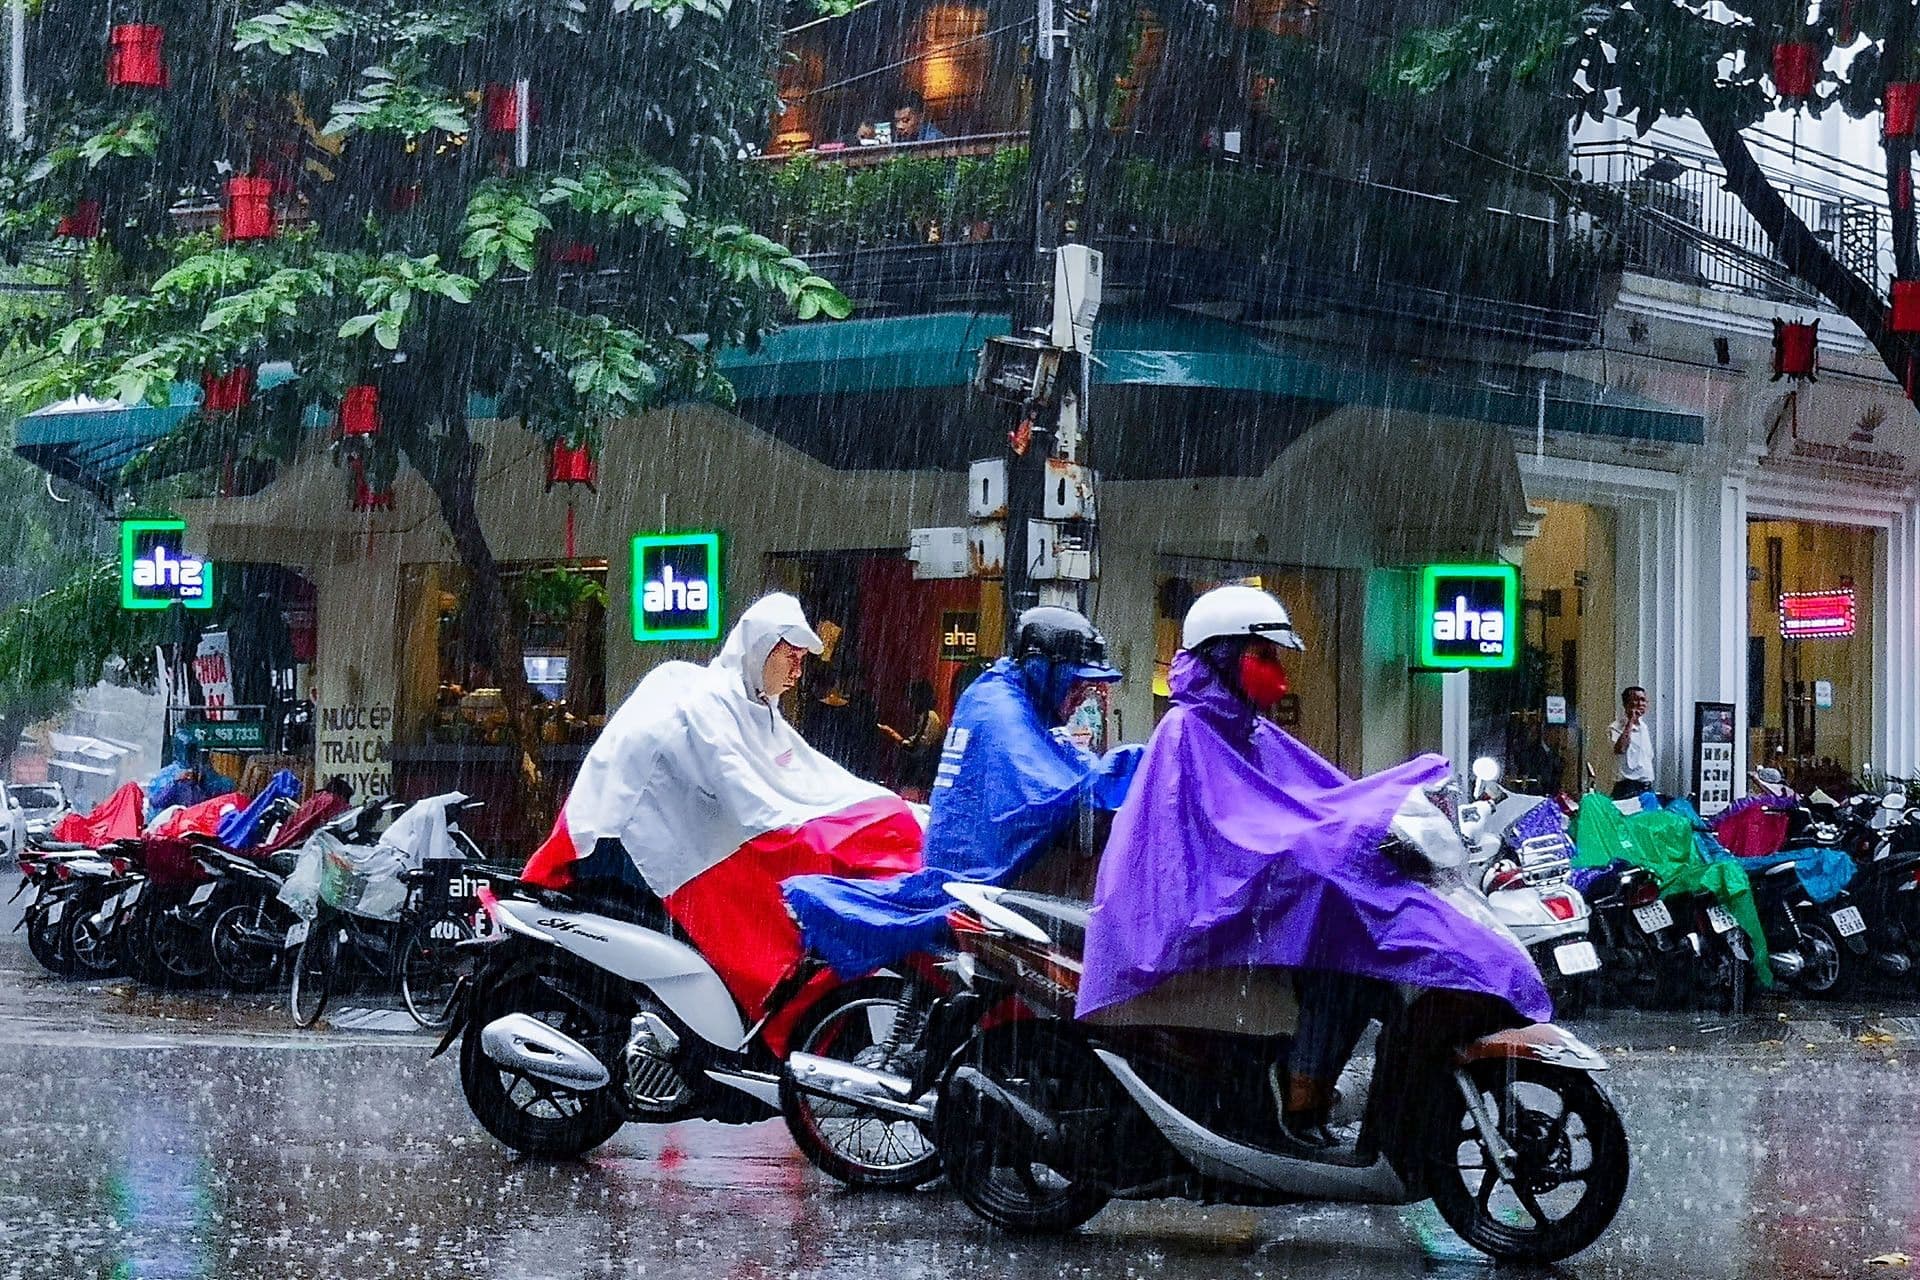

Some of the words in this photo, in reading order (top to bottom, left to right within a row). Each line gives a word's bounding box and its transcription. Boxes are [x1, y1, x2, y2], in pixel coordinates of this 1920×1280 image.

[643, 565, 708, 612] aha
[944, 624, 977, 645] aha
[1433, 595, 1504, 641] aha
[322, 736, 360, 763] TRÁI
